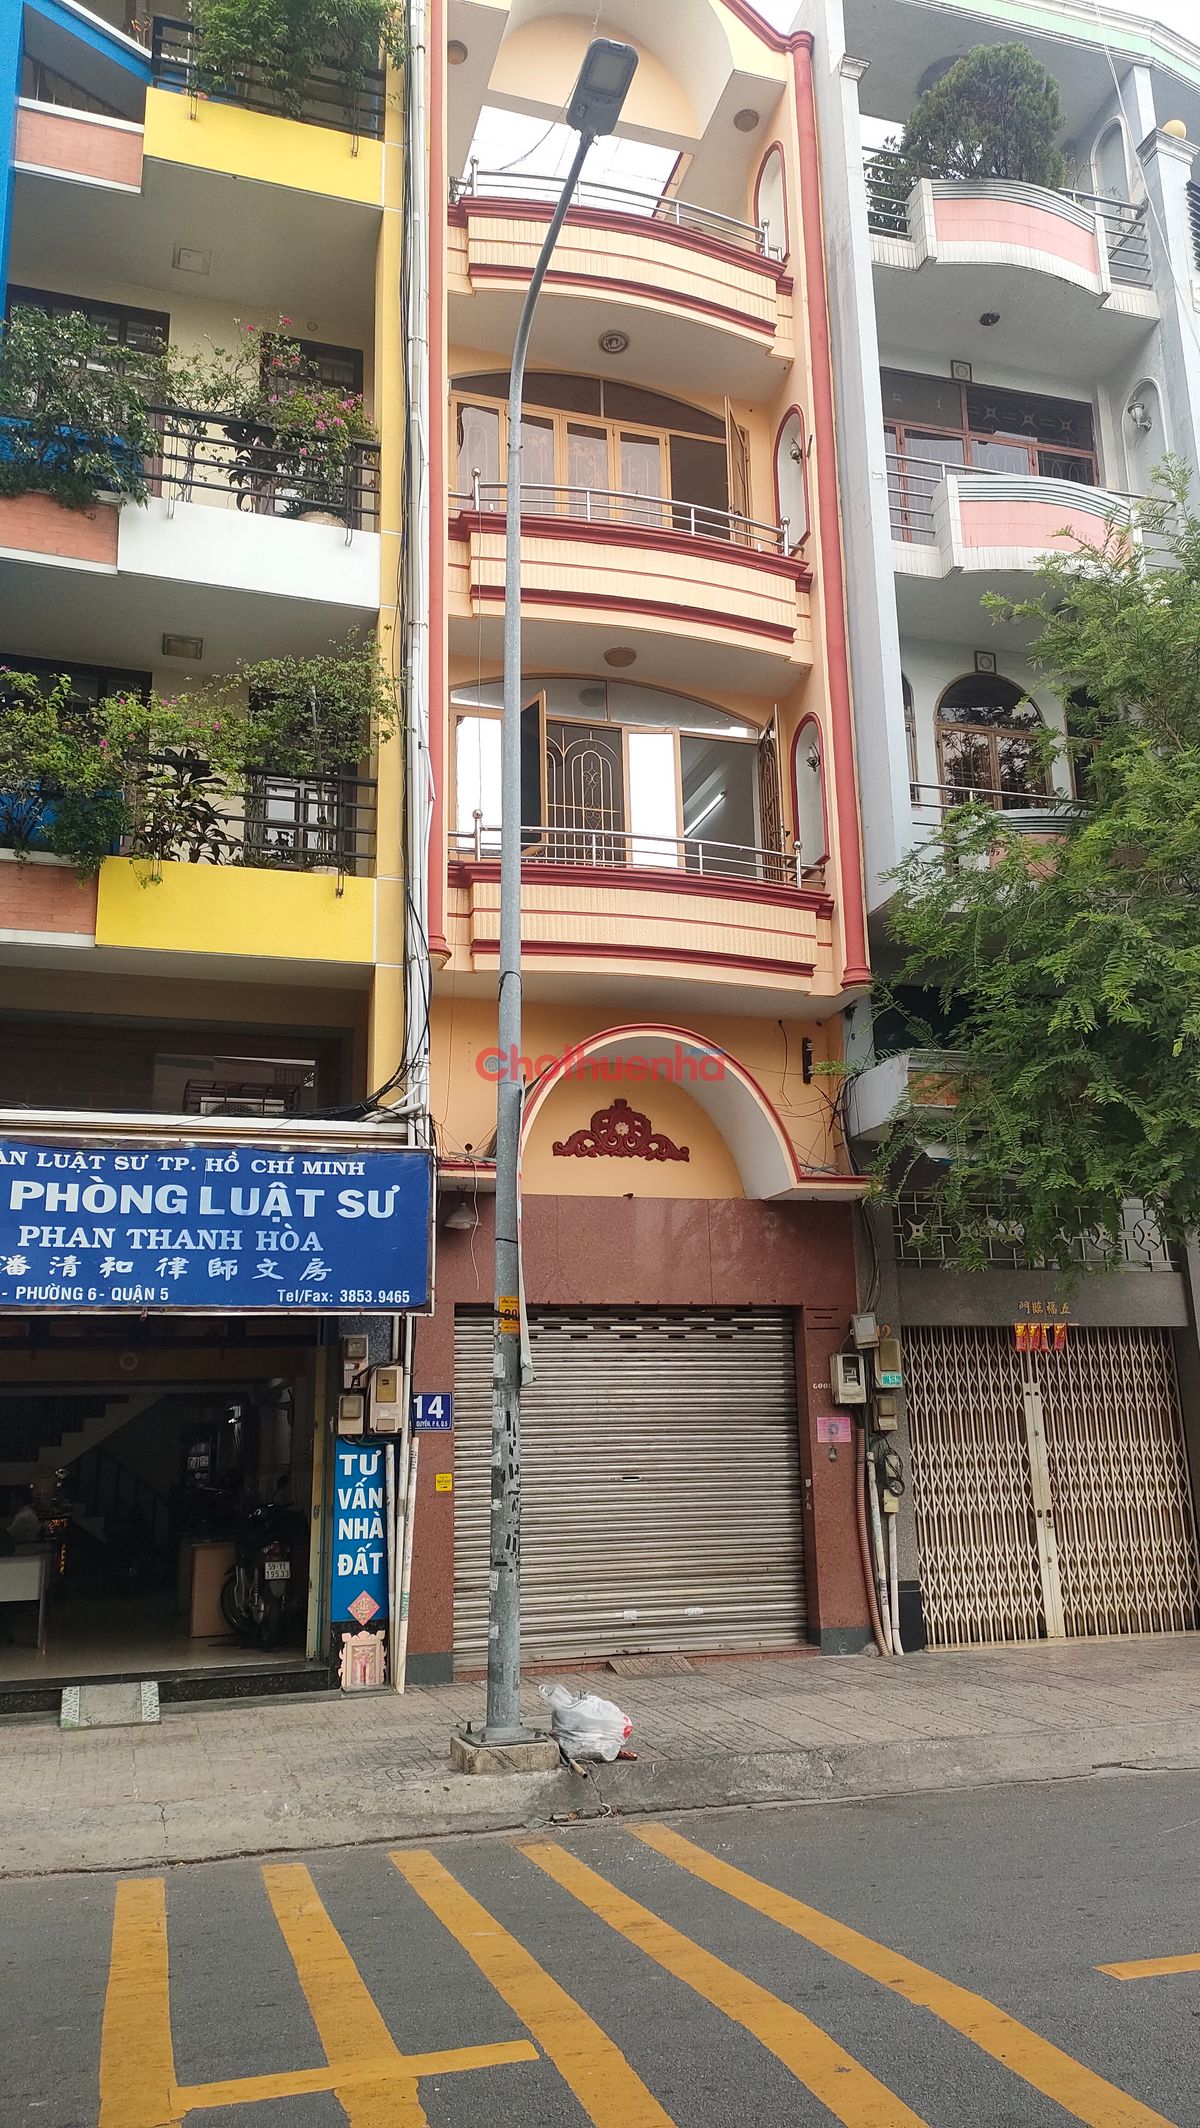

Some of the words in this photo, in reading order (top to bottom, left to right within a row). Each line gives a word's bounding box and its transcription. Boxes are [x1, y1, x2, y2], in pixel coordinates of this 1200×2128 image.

[36, 1151, 106, 1173] LUẬT
[114, 1154, 150, 1171] SƯ
[157, 1156, 197, 1171] TP.
[205, 1151, 240, 1173] HỒ
[250, 1156, 295, 1174] CHÍ
[302, 1160, 366, 1176] MINH
[9, 1175, 188, 1215] PHÒNG
[199, 1181, 325, 1223] LUẬT
[336, 1184, 400, 1219] SƯ
[17, 1225, 116, 1249] PHAN
[126, 1228, 243, 1250] THANH
[255, 1222, 324, 1251] HÒA
[15, 1283, 83, 1301] PHƯỜNG
[111, 1285, 155, 1303] QUẬN
[160, 1287, 169, 1301] 5
[277, 1289, 333, 1303] Tel/Fax:
[339, 1289, 410, 1303] 3853.9465
[413, 1395, 444, 1419] 14
[338, 1450, 382, 1476] TƯ
[337, 1477, 383, 1510] VẤN
[338, 1511, 384, 1540] NHÀ
[337, 1543, 383, 1576] ĐẤT
